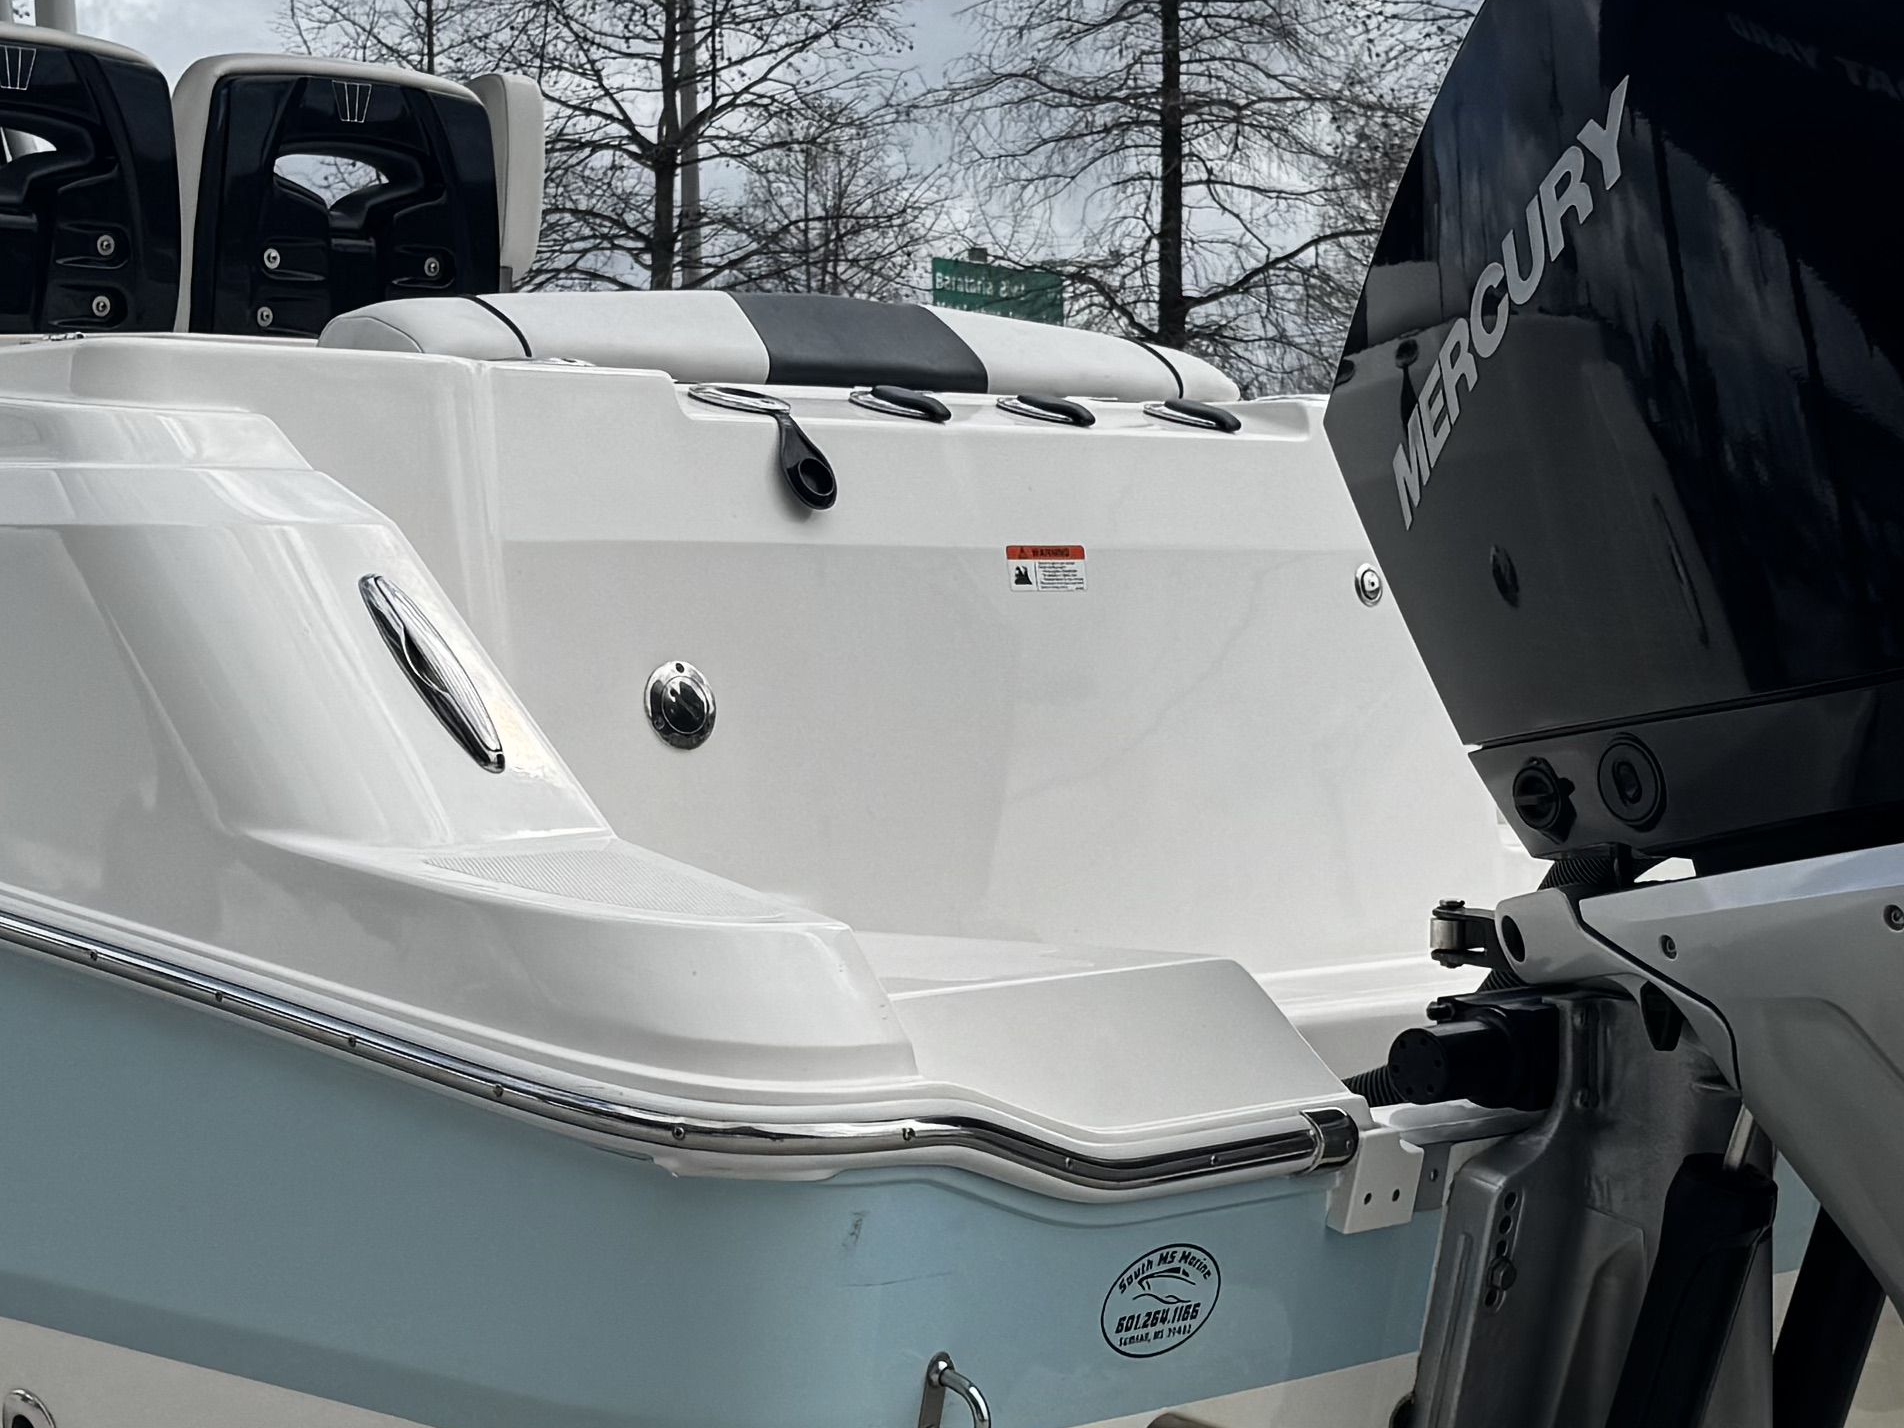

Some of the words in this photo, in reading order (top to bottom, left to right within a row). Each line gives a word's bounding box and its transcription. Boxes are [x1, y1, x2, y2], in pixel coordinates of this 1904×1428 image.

[1392, 75, 1631, 531] MERCURY
[1118, 1259, 1153, 1294] South
[1157, 1251, 1178, 1267] MS
[1179, 1251, 1212, 1280] Marine
